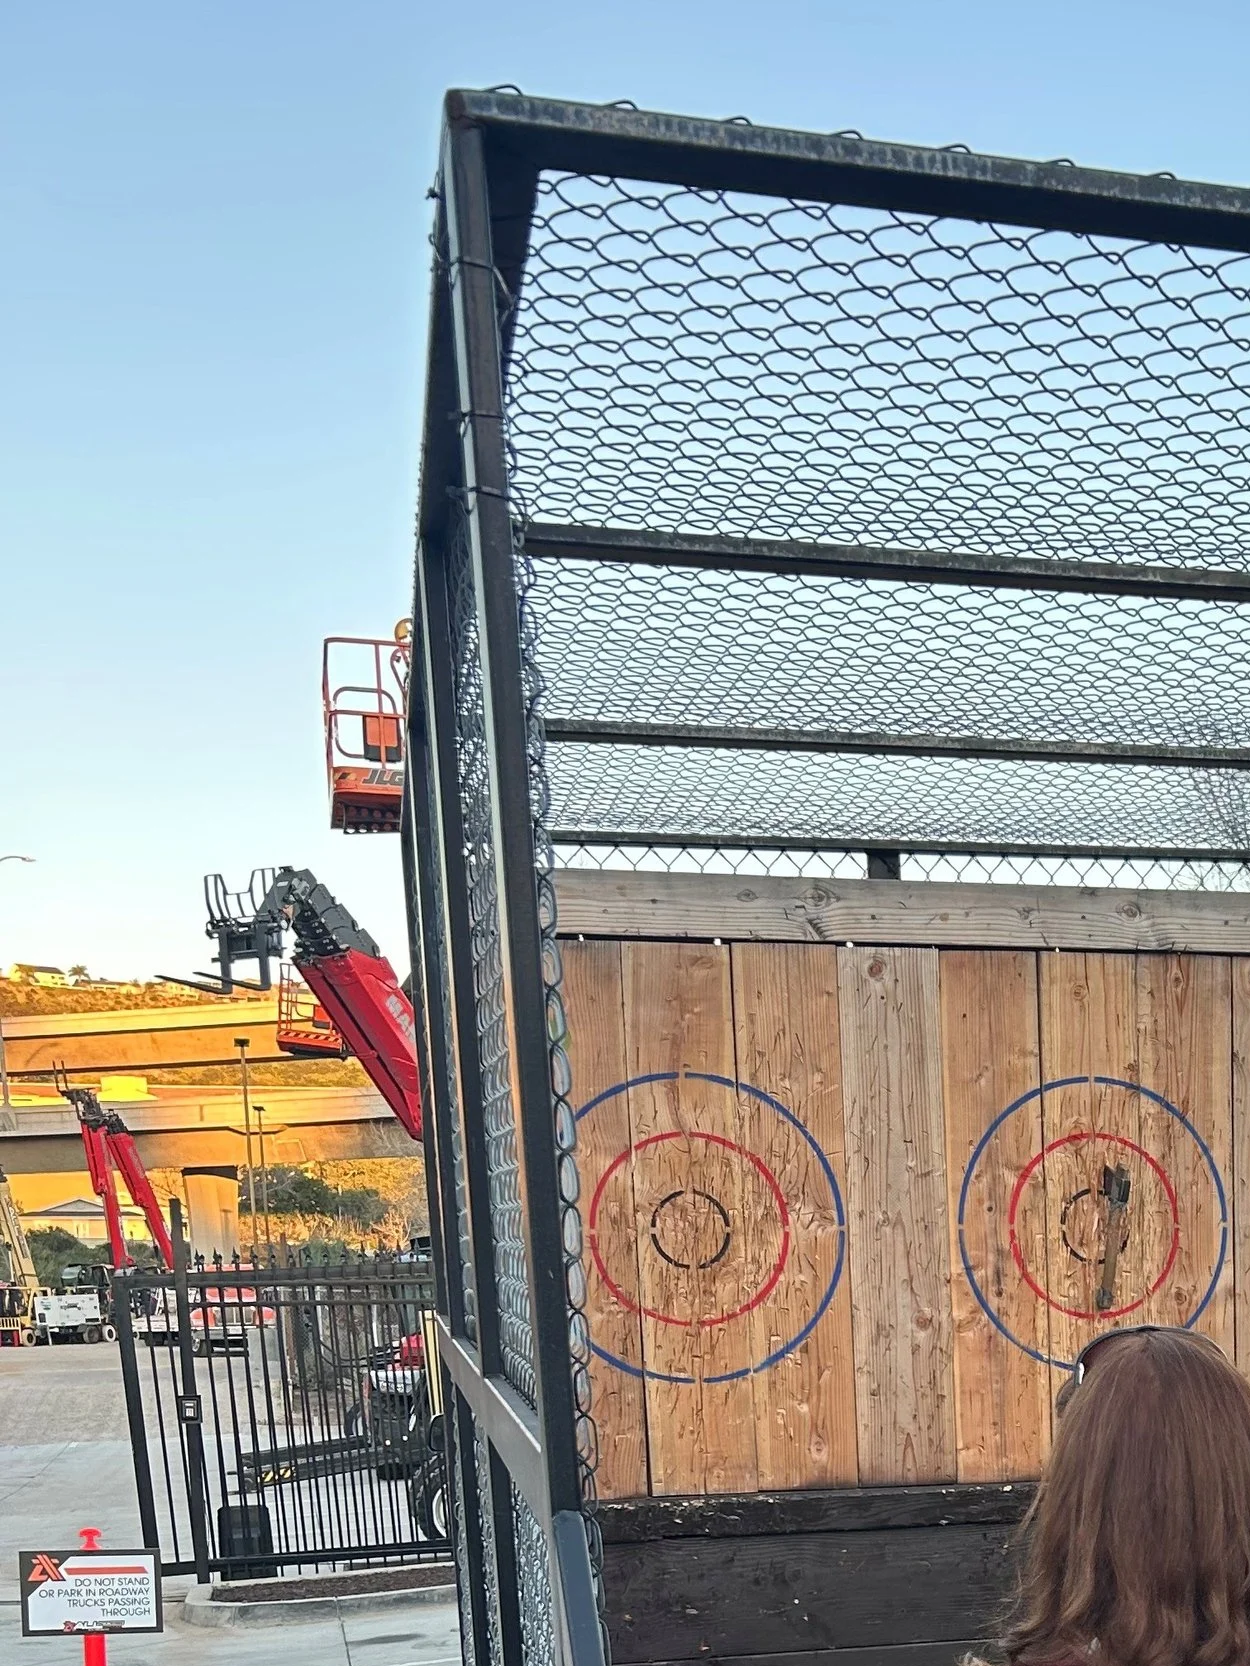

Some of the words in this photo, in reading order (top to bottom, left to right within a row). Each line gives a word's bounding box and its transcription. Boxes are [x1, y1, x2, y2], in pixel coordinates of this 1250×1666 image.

[361, 769, 404, 786] JLG
[74, 1578, 92, 1587] DO
[94, 1577, 116, 1587] NOT
[117, 1576, 150, 1586] STAND
[38, 1589, 55, 1598] OR
[57, 1588, 83, 1598] PARK
[85, 1588, 96, 1597] IN
[98, 1587, 150, 1597] ROADWAY
[67, 1598, 106, 1608] TRUCKS
[108, 1597, 151, 1607] PASSING
[101, 1607, 151, 1617] THROUGH
